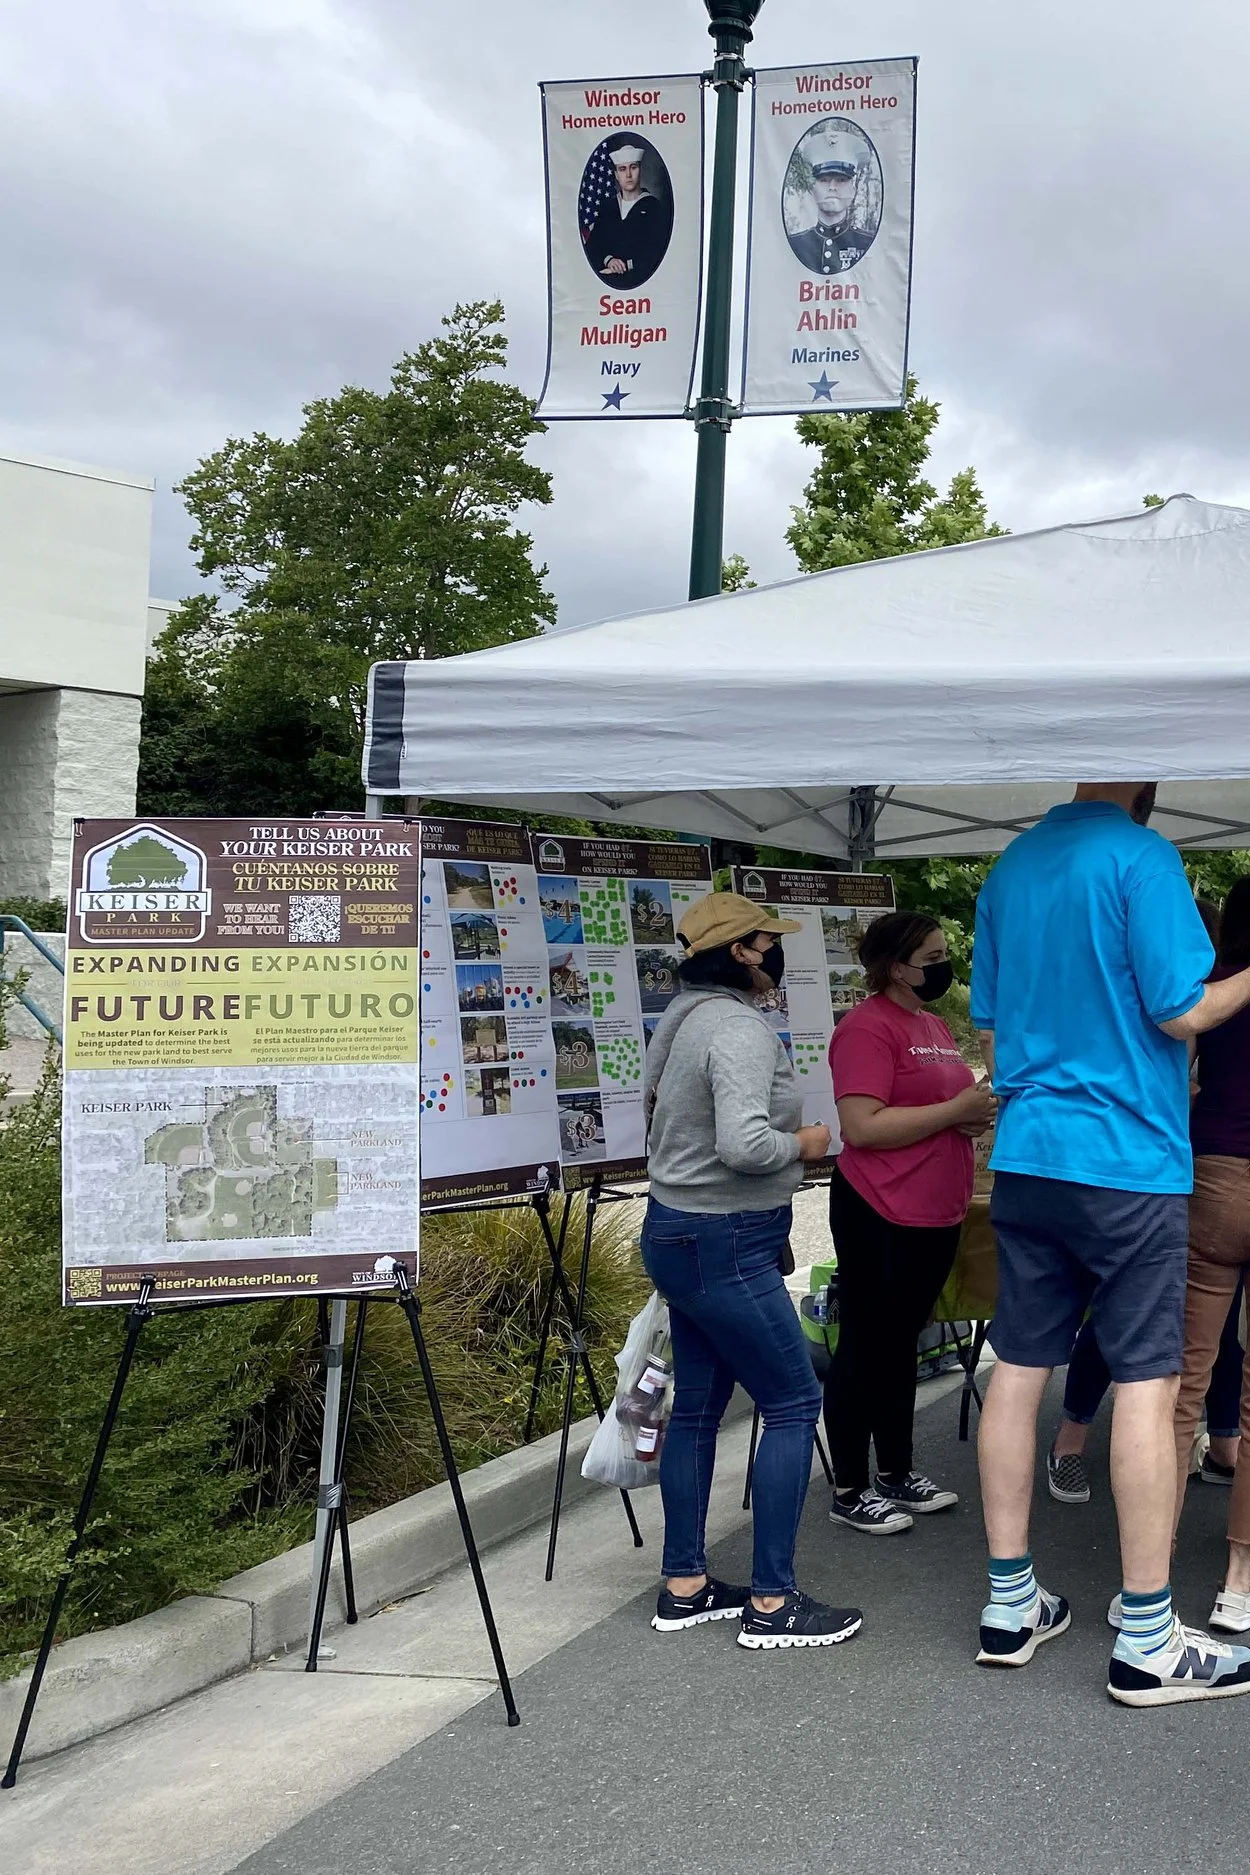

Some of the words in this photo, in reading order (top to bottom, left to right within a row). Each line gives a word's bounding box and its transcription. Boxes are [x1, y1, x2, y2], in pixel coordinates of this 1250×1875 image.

[796, 73, 872, 93] Windsor
[584, 88, 660, 107] Windsor
[772, 99, 854, 115] Hometown
[861, 95, 897, 109] Hero
[562, 115, 644, 129] Hometown
[649, 110, 686, 124] Hero
[799, 280, 859, 302] Brian
[600, 295, 650, 316] Sean
[797, 308, 857, 331] Ahlin
[581, 324, 666, 348] Mulligan
[792, 347, 859, 363] Marines
[601, 361, 641, 378] Navy
[250, 827, 293, 839] TELL
[298, 828, 320, 840] US
[324, 828, 383, 840] ABOUT
[219, 841, 276, 856] YOUR
[282, 843, 357, 856] KEISER
[361, 843, 413, 856] PARK
[232, 859, 338, 875] CUÉNTANOS
[342, 864, 399, 875] SOBRE
[234, 877, 262, 891] TU
[266, 877, 339, 891] KEISER
[345, 878, 398, 891] PARK
[88, 894, 200, 910] KEISER
[223, 904, 242, 912] WE
[244, 904, 281, 912] WANT
[344, 904, 413, 914] ¡QUEREMOS
[106, 913, 182, 922] PARK
[225, 915, 242, 923] TO
[244, 915, 278, 923] HEAR
[348, 915, 410, 923] ESCUCHAR
[545, 900, 574, 924] $4
[637, 902, 666, 926] $2
[217, 926, 255, 935] FROM
[256, 926, 284, 934] YOU!
[361, 926, 378, 934] DE
[73, 956, 240, 973] EXPANDING
[252, 951, 408, 972] EXPANSIÓN
[552, 971, 581, 996] $4
[645, 969, 673, 994] $2
[71, 995, 240, 1021] FUTURE
[245, 993, 414, 1020] FUTURO
[78, 1040, 103, 1048] being
[105, 1039, 143, 1047] updated
[143, 1049, 160, 1057] park
[560, 1042, 589, 1068] $3
[82, 1103, 130, 1114] KEISER
[135, 1102, 172, 1112] PARK
[351, 1131, 373, 1139] NEW
[567, 1114, 596, 1141] $3
[351, 1138, 401, 1146] PARKLAND
[351, 1174, 373, 1182] NEW
[351, 1181, 401, 1189] PARKLAND
[421, 1182, 508, 1201] erParkMasterPlan.org
[106, 1273, 318, 1293] wwweiserParkMasterPlan.org
